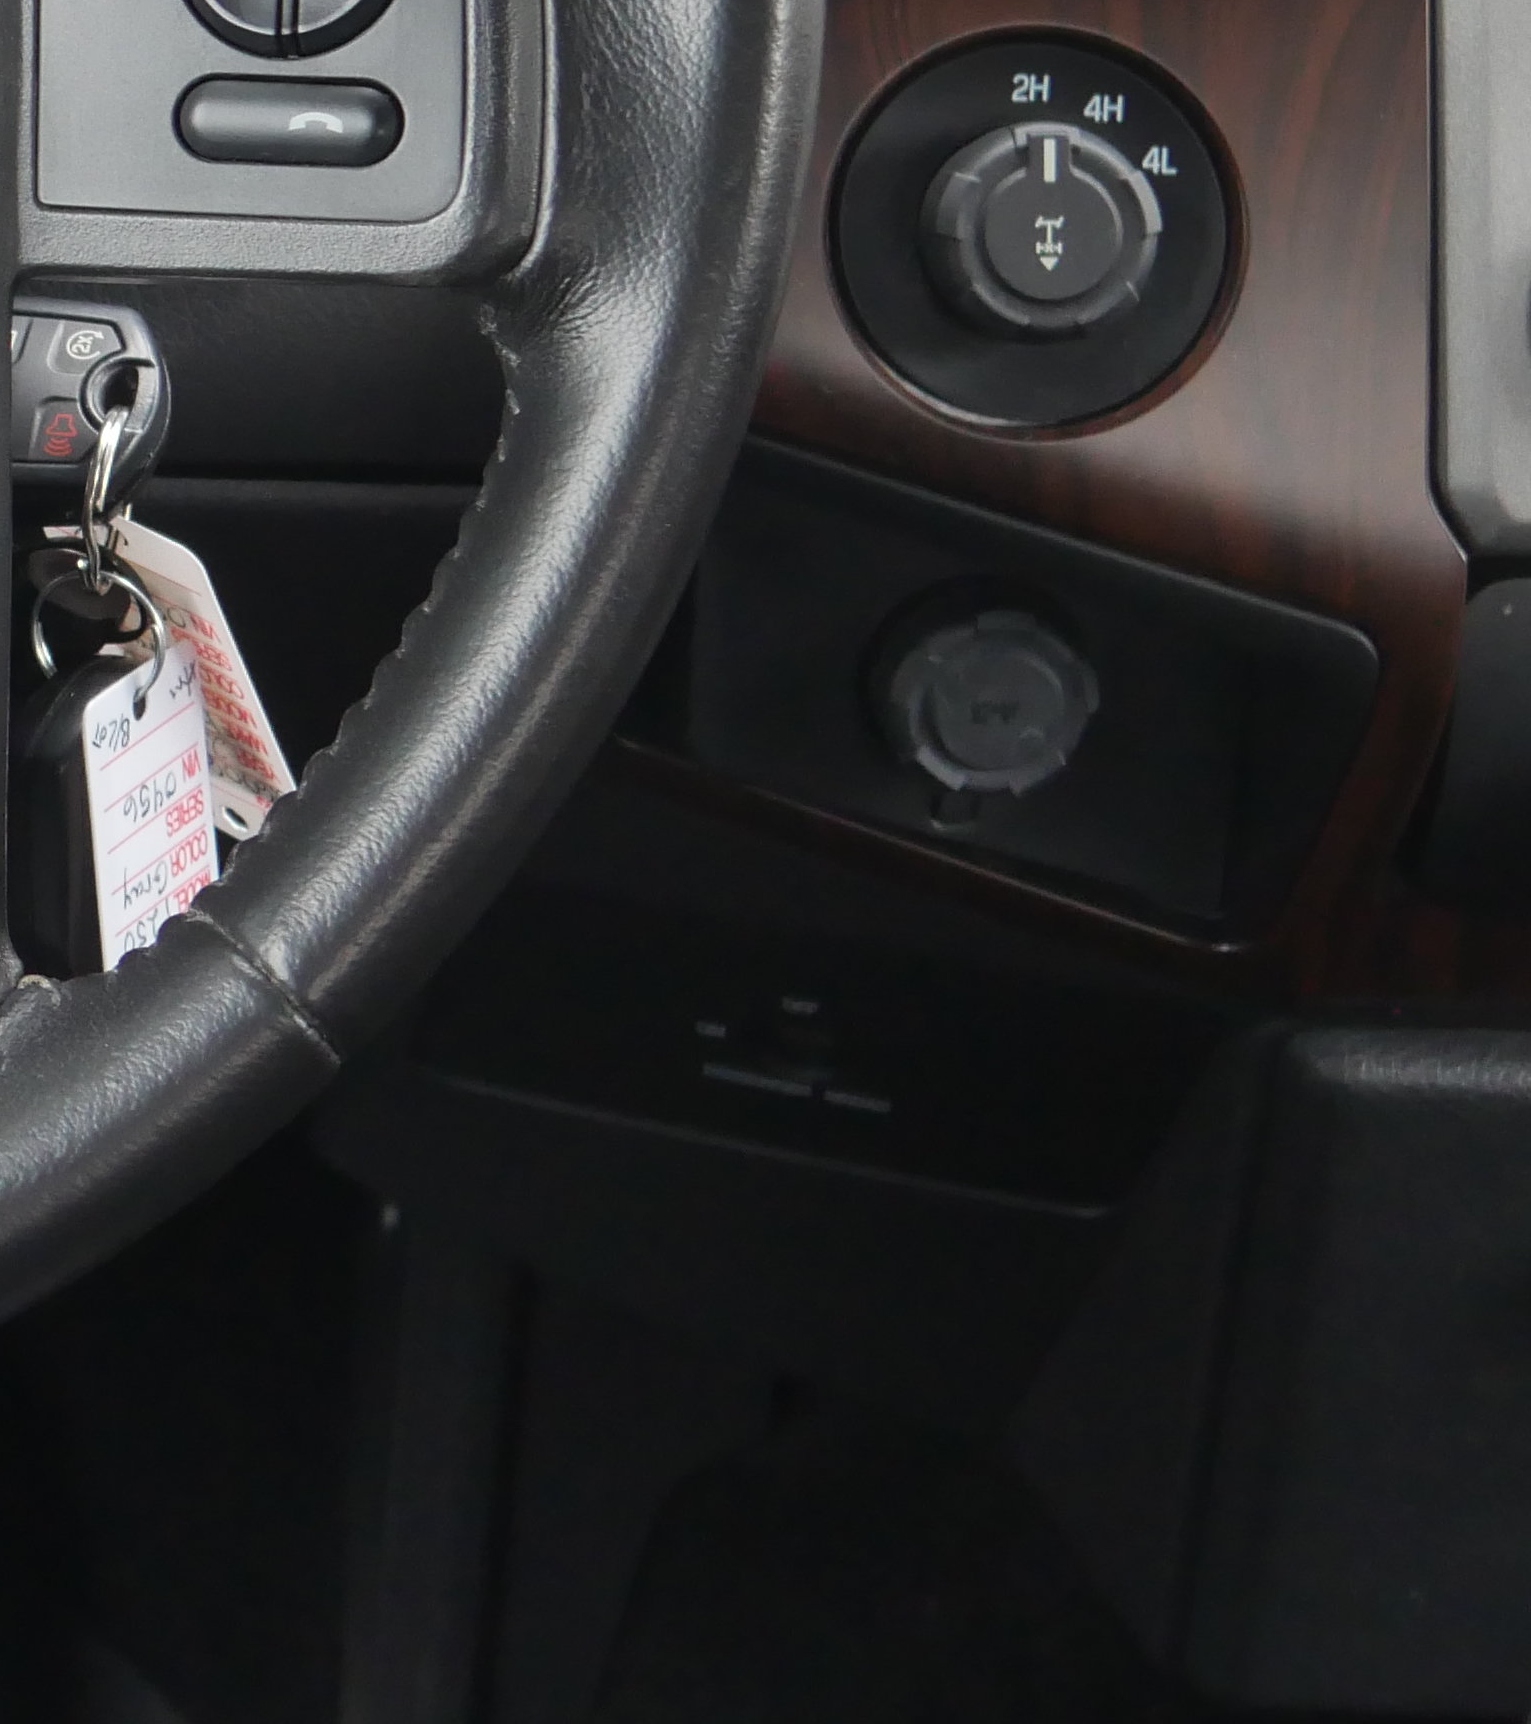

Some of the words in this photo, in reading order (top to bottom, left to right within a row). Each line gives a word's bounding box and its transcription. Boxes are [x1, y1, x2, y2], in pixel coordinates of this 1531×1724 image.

[1011, 74, 1051, 104] 2H
[1083, 94, 1125, 124] 4H
[1141, 146, 1177, 176] 4L
[182, 750, 202, 784] VIN
[165, 789, 204, 838] SERIES
[169, 829, 208, 878] COLOR
